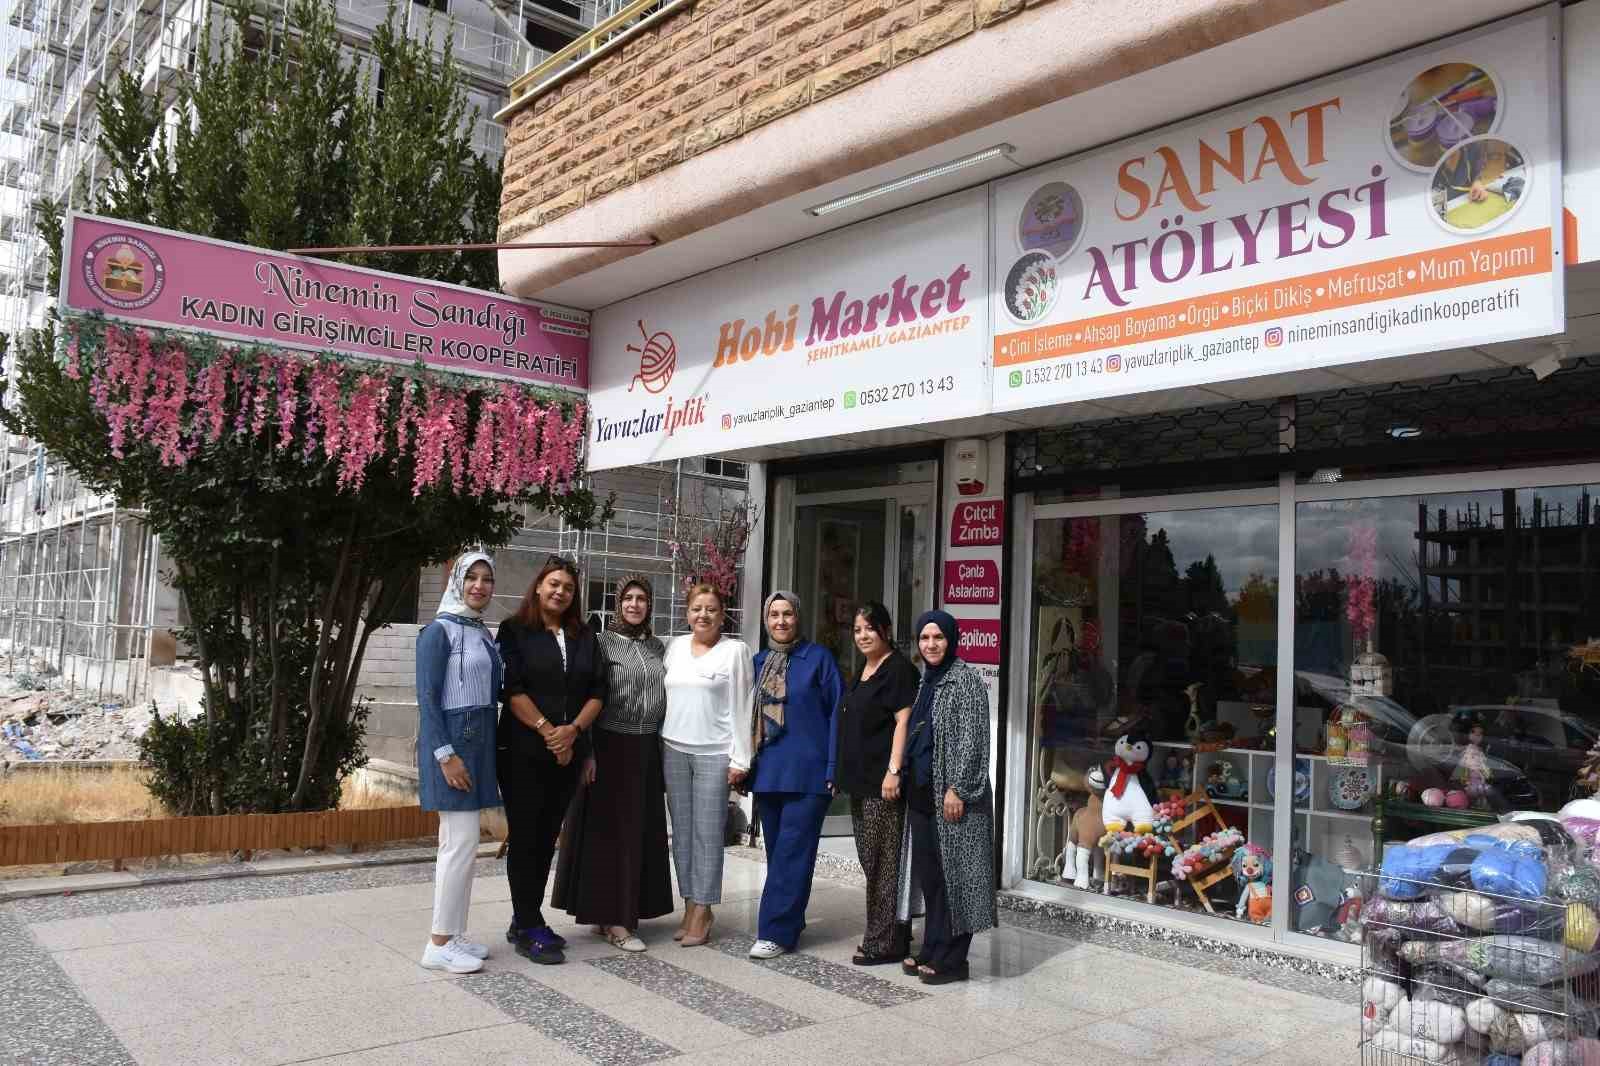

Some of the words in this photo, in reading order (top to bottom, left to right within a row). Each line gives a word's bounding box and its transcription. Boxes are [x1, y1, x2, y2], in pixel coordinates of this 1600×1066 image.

[1114, 97, 1343, 221] SANAT
[1083, 164, 1391, 307] ATÖLYESİ
[255, 261, 399, 313] Ninemin
[409, 290, 527, 345] Sandığı
[712, 304, 799, 368] Hobi
[804, 263, 971, 347] Market
[1009, 337, 1031, 360] Çini
[1083, 323, 1121, 345] Ahşap
[1125, 312, 1176, 338] Boyama
[1187, 301, 1219, 328] Örgü
[1232, 291, 1268, 319] Biçki
[1273, 285, 1312, 309] Dikiş
[1328, 267, 1406, 300] Mefruşat
[1420, 259, 1465, 282] Mum
[1471, 245, 1536, 276] Yapımı
[181, 296, 265, 328] KADIN
[273, 310, 433, 354] GİRİŞİMCİLER
[441, 339, 577, 380] KOOPERATİFİ
[807, 315, 971, 364] ŞEHİTKAMİL/GAZİANTEP
[1055, 363, 1072, 381] 270
[1077, 360, 1087, 377] 13
[1090, 358, 1103, 374] 43
[1288, 288, 1520, 344] nineminsandigikadinkooperatifi
[860, 386, 889, 406] 0532
[892, 382, 915, 402] 270
[919, 379, 934, 396] 13
[937, 375, 955, 392] 43
[596, 394, 705, 443] Yavuzlarİplik
[959, 525, 1000, 541] Zımba
[963, 505, 995, 524] Çıtçıt
[948, 583, 995, 599] Astarlama
[958, 564, 985, 581] Çanta
[958, 627, 998, 651] apitone
